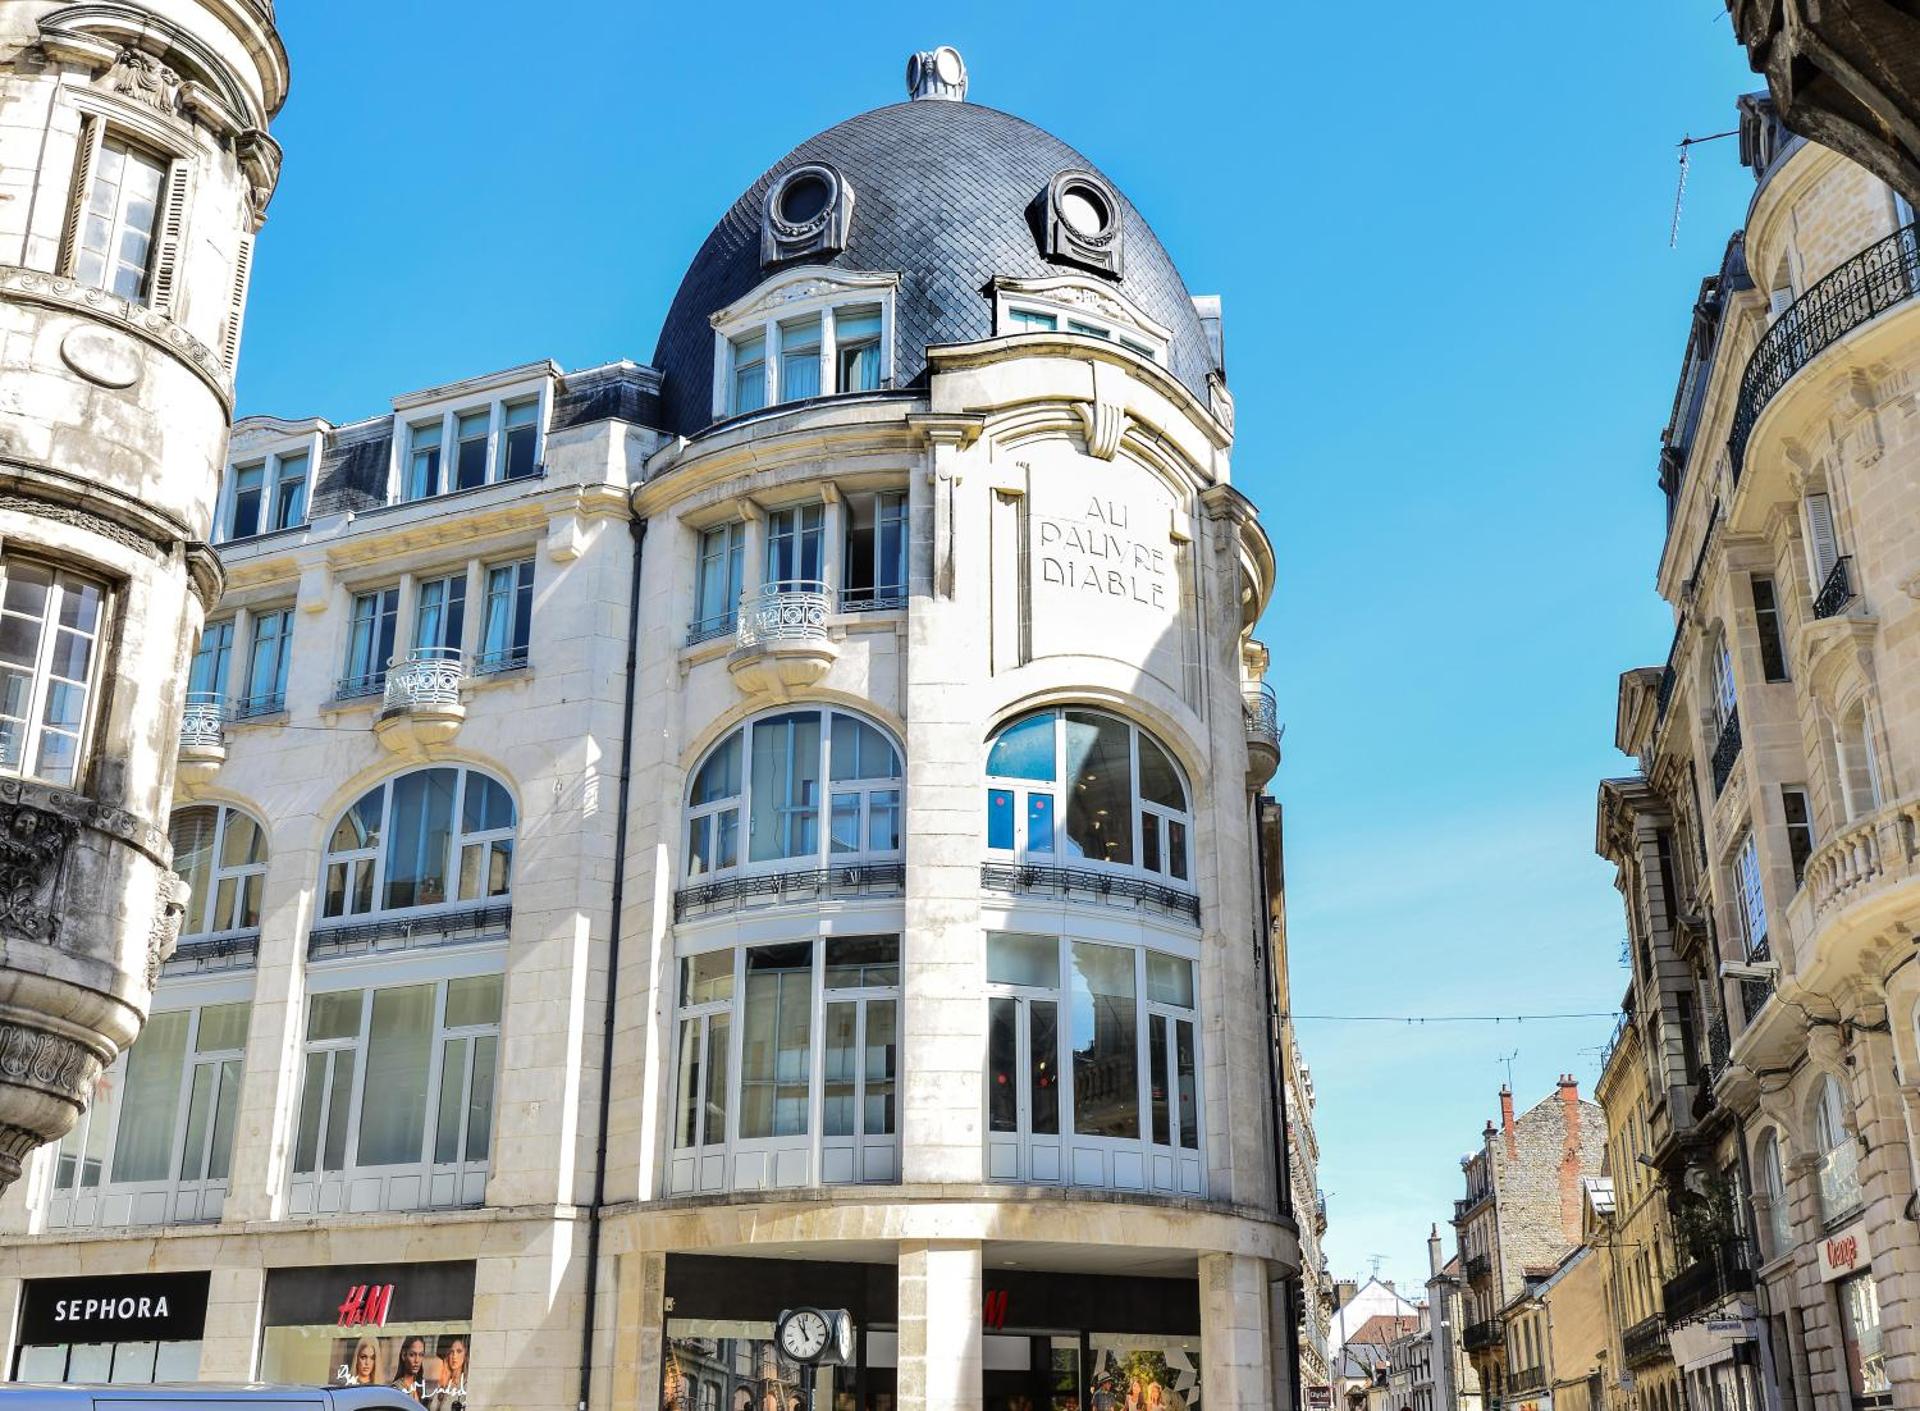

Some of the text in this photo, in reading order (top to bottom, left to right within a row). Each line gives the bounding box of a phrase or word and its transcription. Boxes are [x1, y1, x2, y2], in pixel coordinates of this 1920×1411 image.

[1040, 521, 1166, 577] PAUVRE
[54, 1296, 169, 1321] SEPHORA
[337, 1284, 394, 1328] H&M
